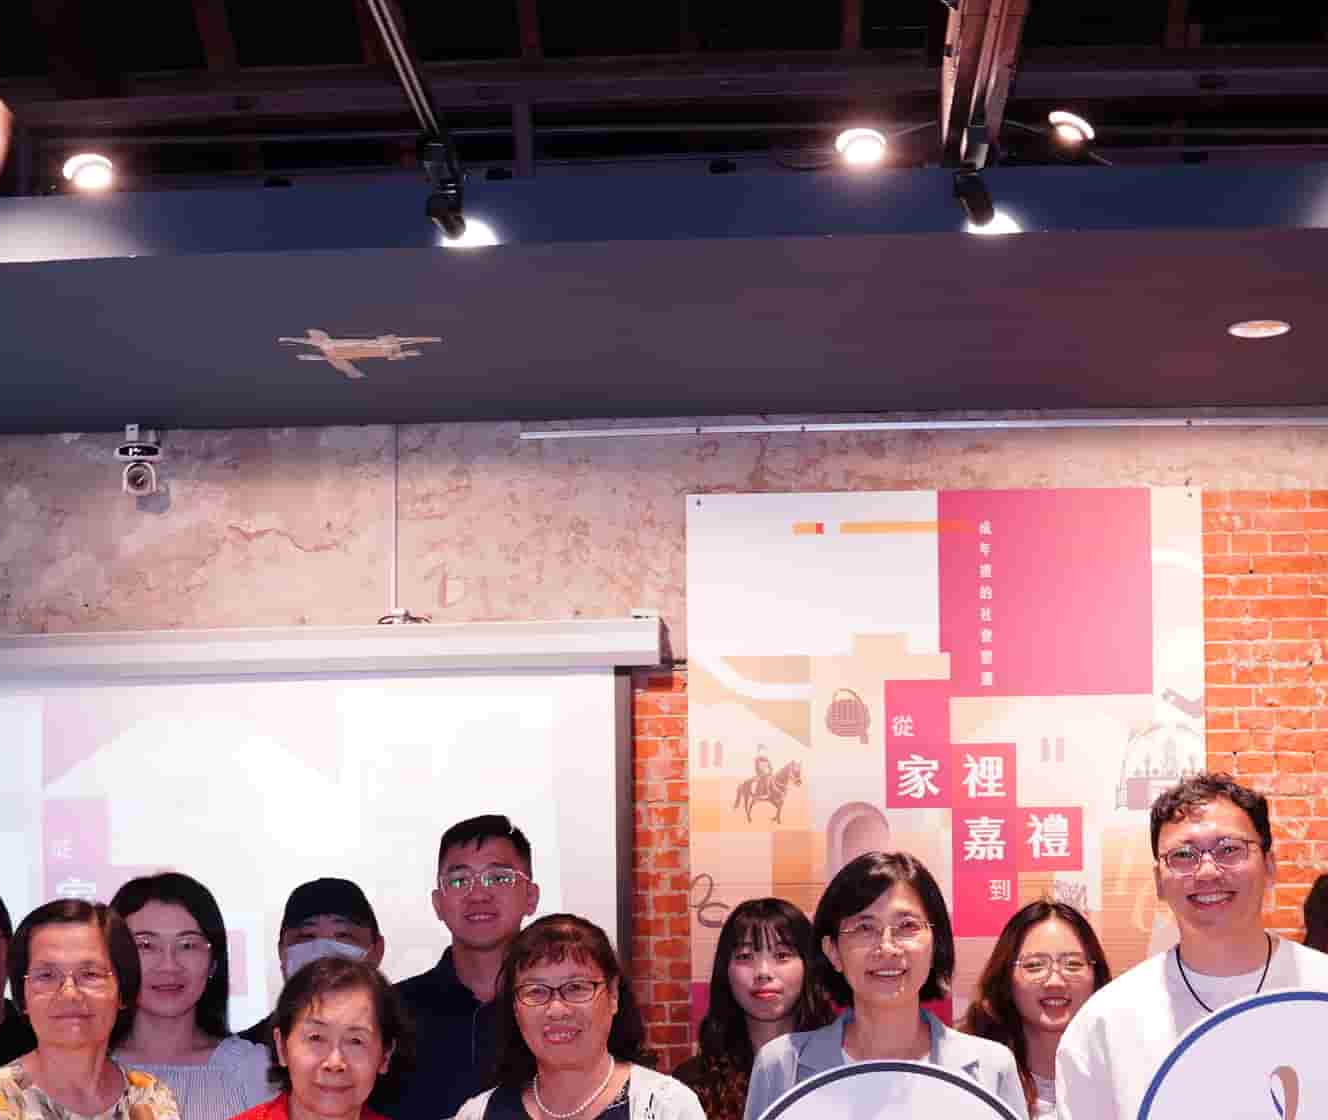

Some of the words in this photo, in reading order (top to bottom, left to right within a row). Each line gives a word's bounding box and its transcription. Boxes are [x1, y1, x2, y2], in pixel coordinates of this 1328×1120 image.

[892, 714, 914, 737] 從
[896, 753, 1007, 799] 家裡
[963, 814, 1071, 861] 嘉禮
[987, 879, 1012, 901] 到
